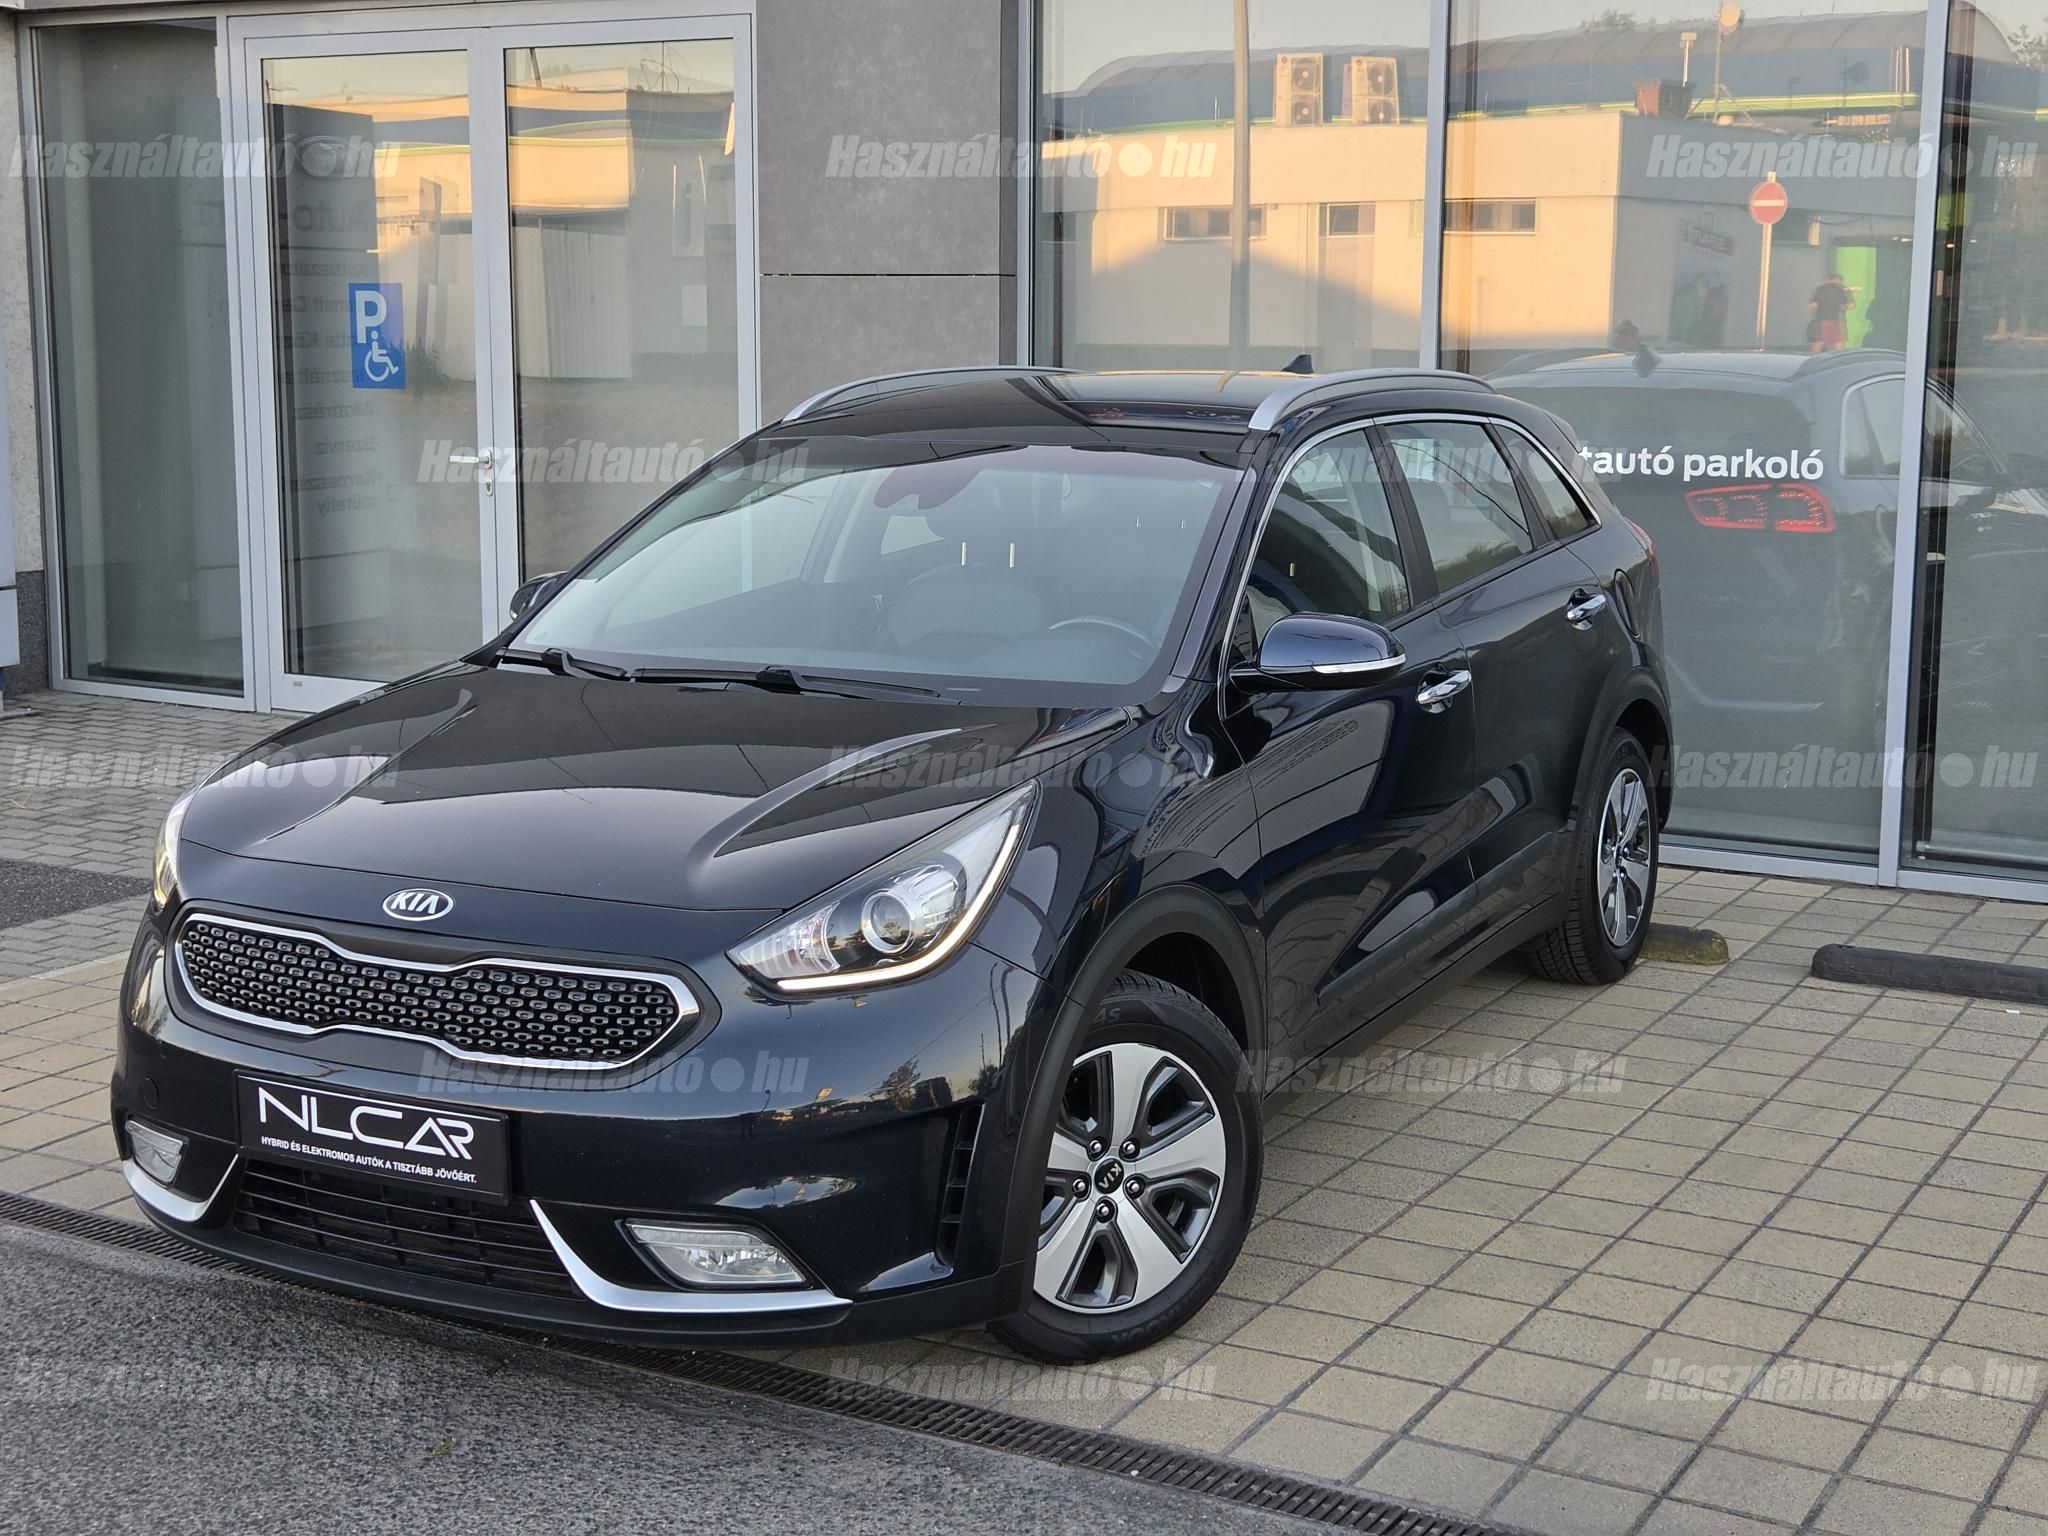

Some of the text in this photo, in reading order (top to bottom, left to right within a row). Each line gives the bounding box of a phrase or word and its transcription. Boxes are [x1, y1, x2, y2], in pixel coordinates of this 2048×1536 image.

[355, 290, 387, 344] P
[1683, 449, 1824, 482] parkoló
[388, 890, 441, 915] KIA
[258, 1086, 475, 1160] NLCAR
[261, 1135, 290, 1150] HYBRID
[290, 1140, 302, 1152] ÉS
[302, 1144, 355, 1162] ELEKTROMOS
[355, 1154, 385, 1169] AUTÓK
[385, 1160, 392, 1170] A
[392, 1161, 434, 1177] TISZTÁBB
[1098, 1162, 1123, 1190] KIA
